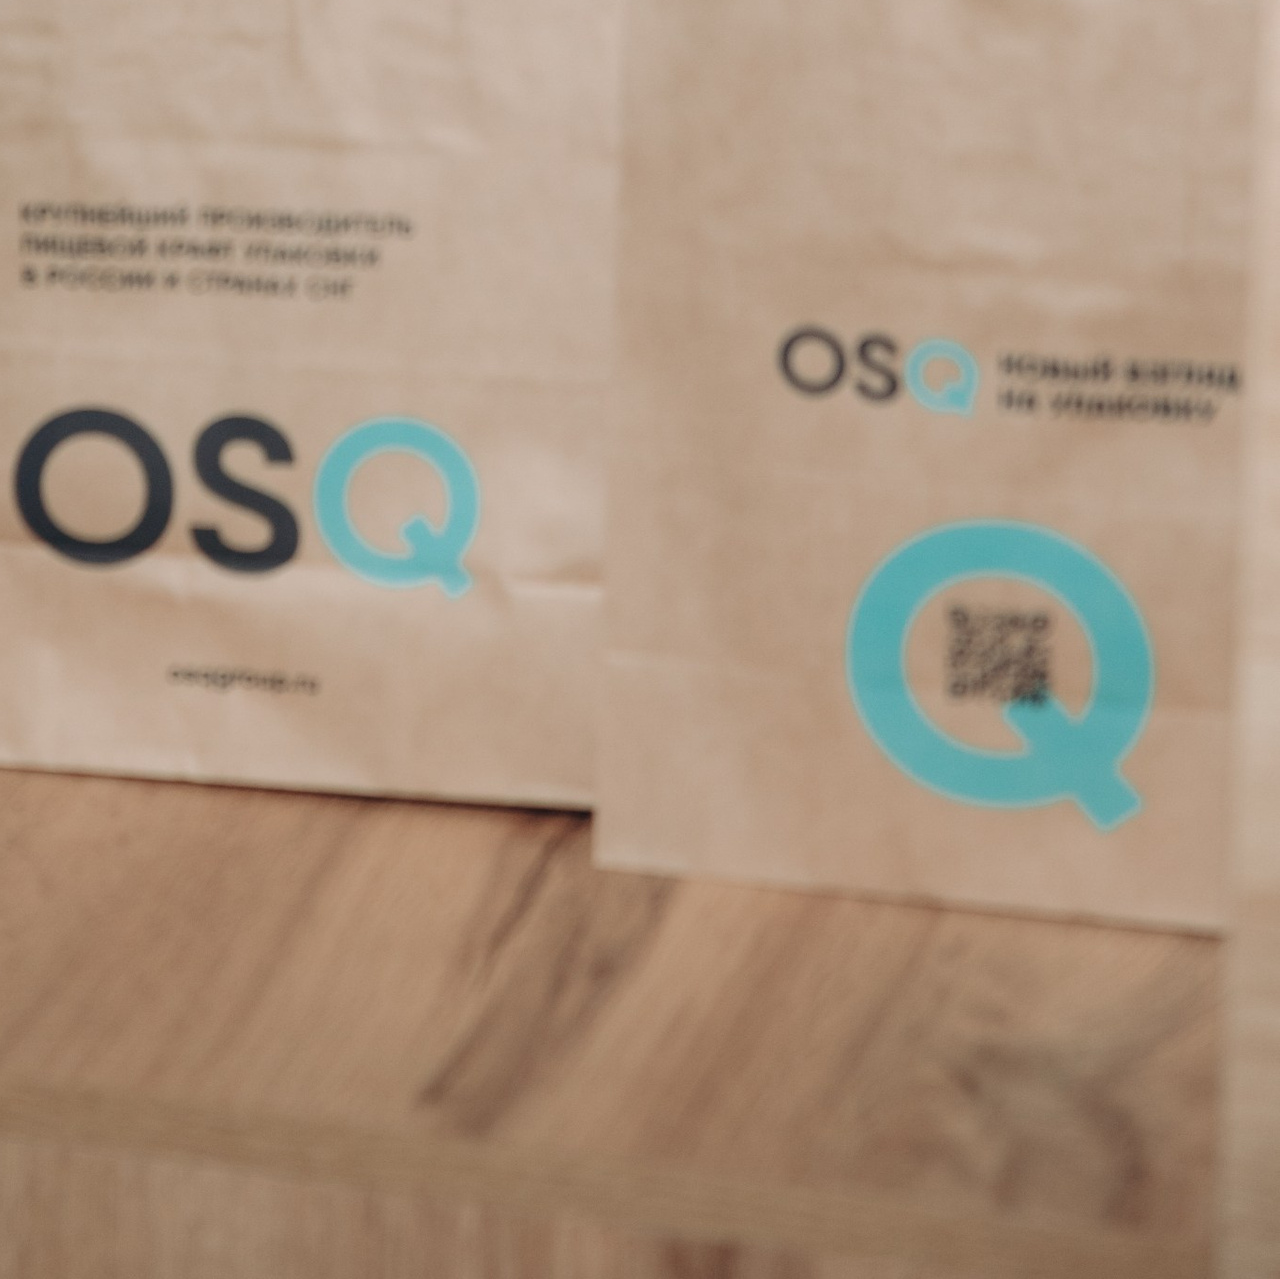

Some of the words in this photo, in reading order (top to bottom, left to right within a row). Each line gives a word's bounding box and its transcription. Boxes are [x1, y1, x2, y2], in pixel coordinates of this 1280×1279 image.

[779, 326, 978, 417] OSQ
[14, 407, 480, 597] OSQ
[847, 518, 1154, 833] Q
